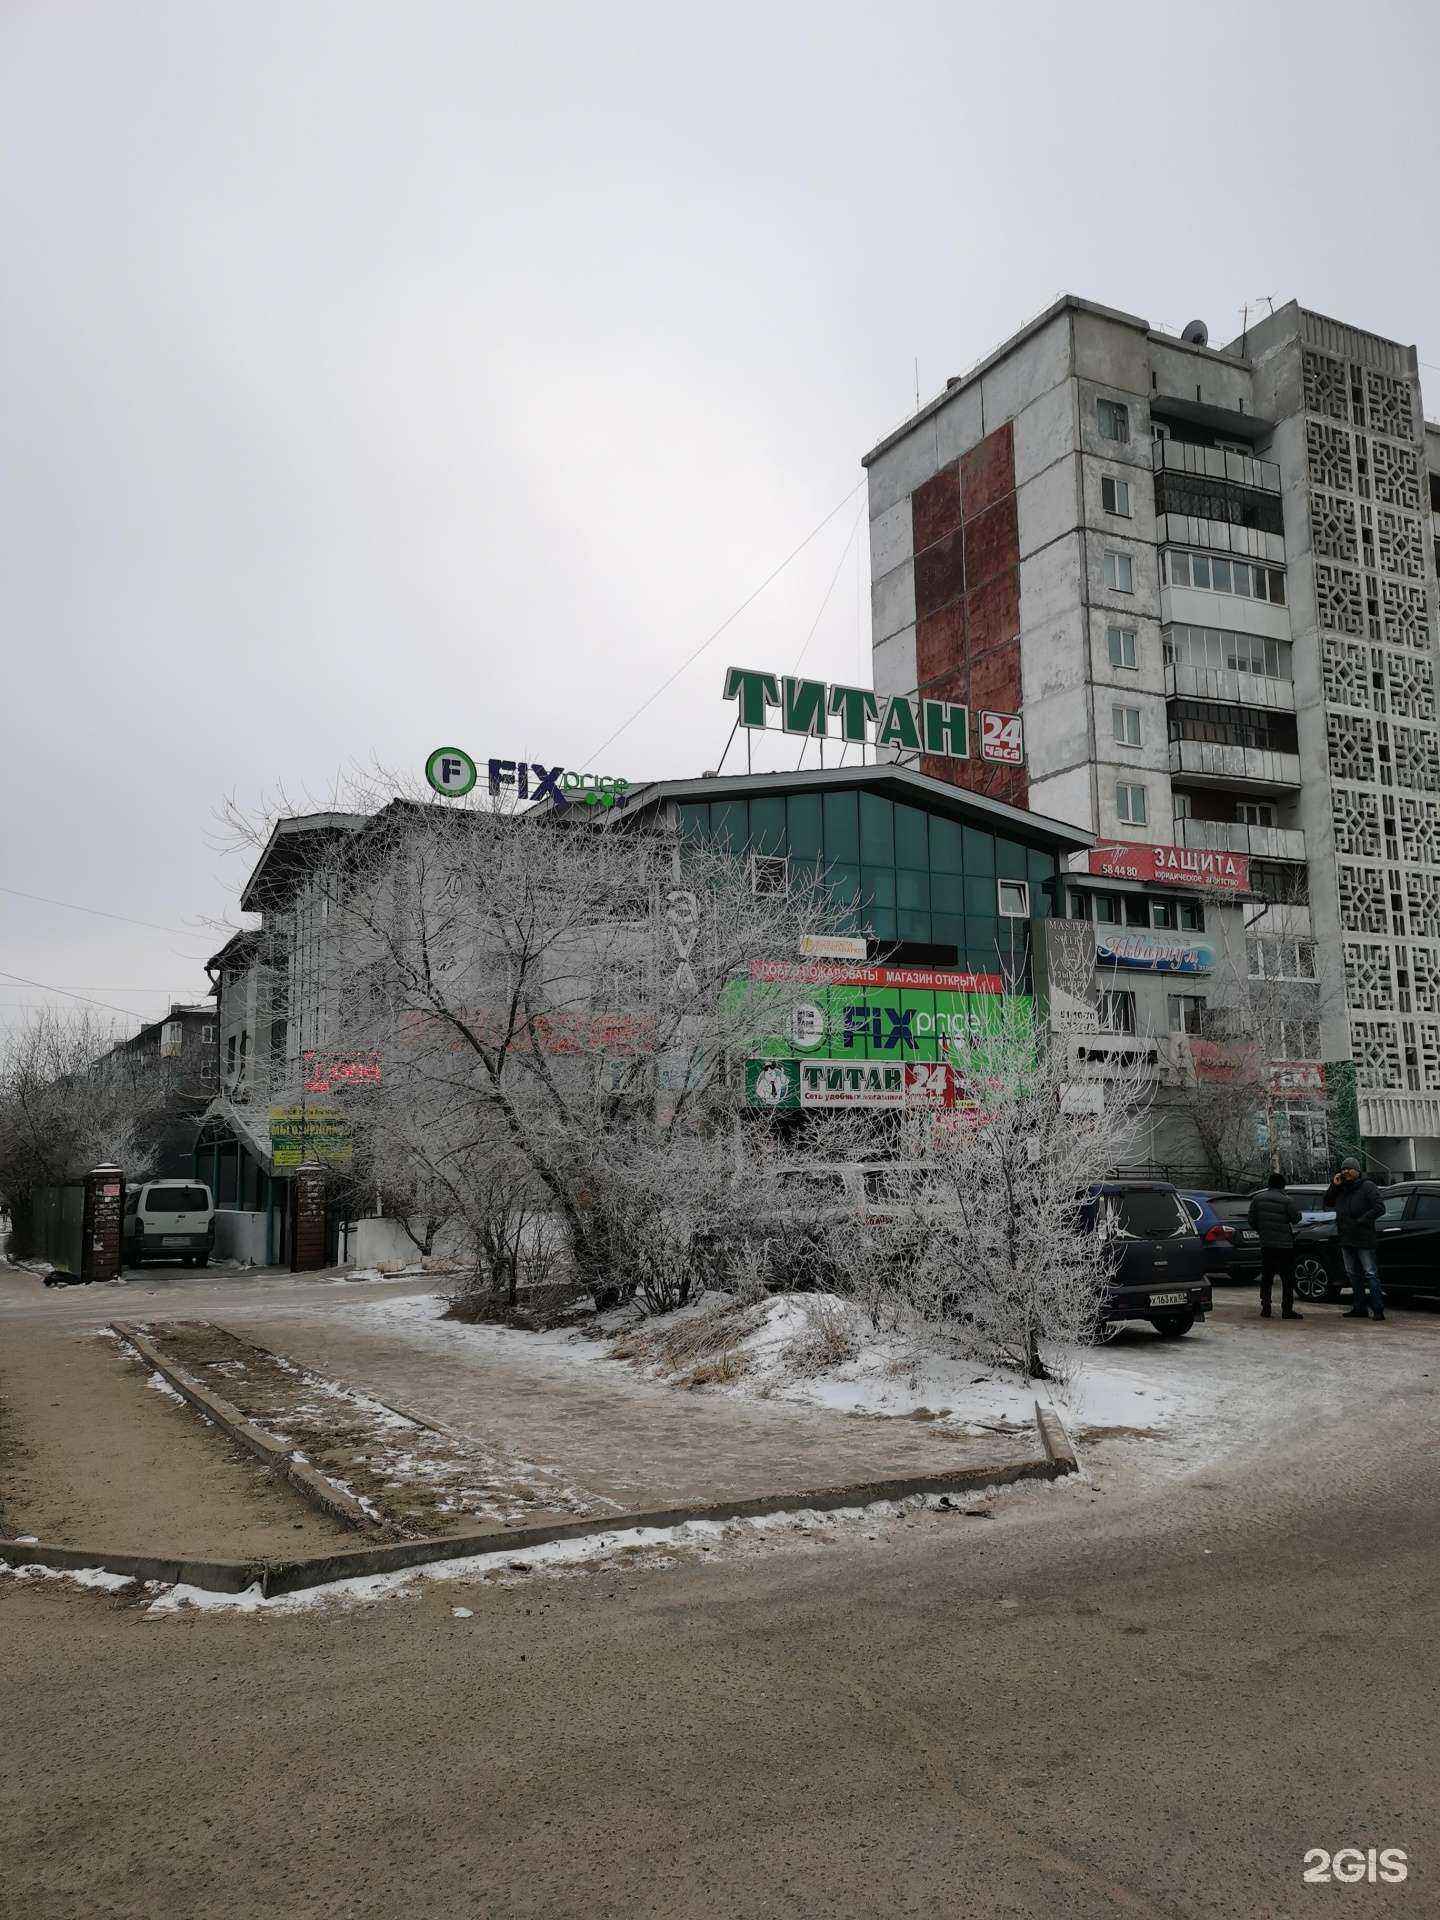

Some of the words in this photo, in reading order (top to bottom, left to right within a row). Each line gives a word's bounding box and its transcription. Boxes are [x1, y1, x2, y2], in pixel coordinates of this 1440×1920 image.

[723, 666, 970, 760] ТИТАН
[984, 716, 1020, 748] 24
[985, 745, 1020, 760] часа
[488, 758, 571, 810] FIX
[563, 770, 630, 794] price
[1153, 847, 1237, 876] ЗАЩИТА
[886, 971, 933, 986] МАГАЗИН
[935, 974, 977, 988] ОТКРЫТ
[842, 1005, 919, 1050] FIX
[916, 1010, 981, 1036] price
[803, 1065, 902, 1093] ТИТАН
[907, 1065, 948, 1093] 24
